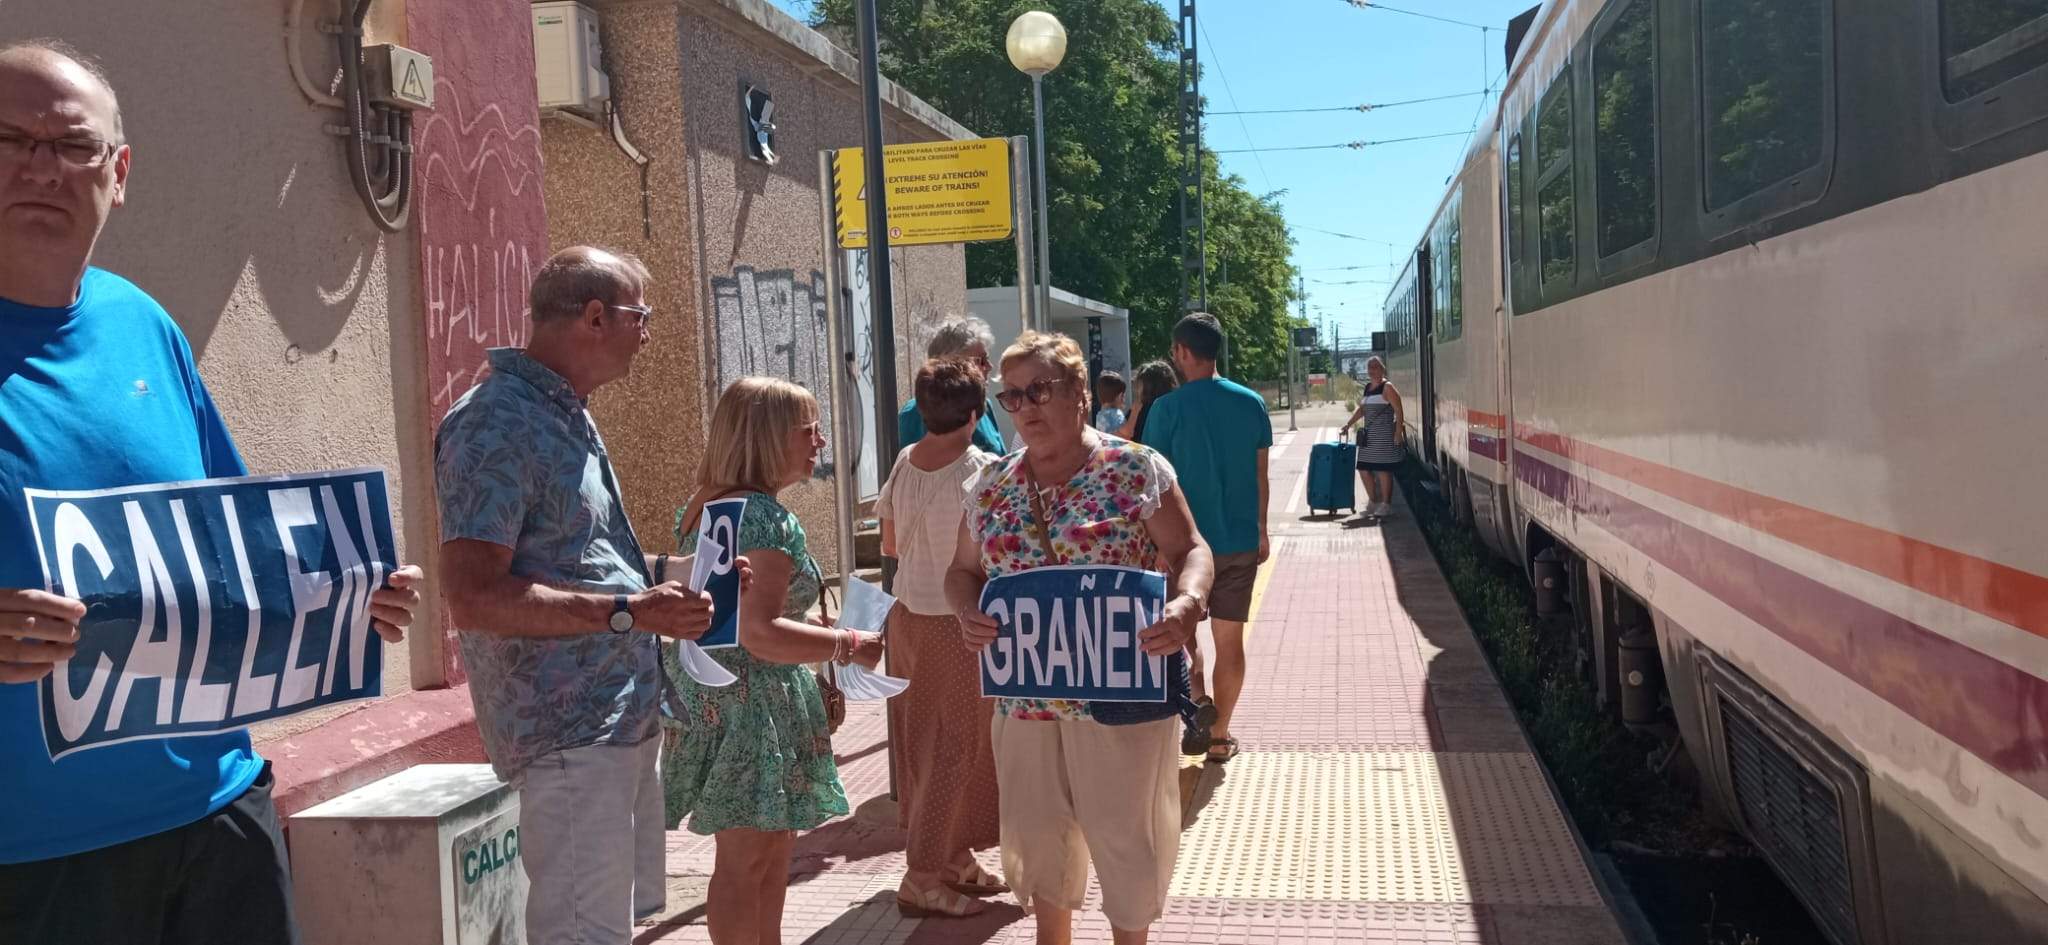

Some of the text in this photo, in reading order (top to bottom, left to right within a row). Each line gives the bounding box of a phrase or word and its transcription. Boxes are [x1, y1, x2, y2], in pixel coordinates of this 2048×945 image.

[928, 152, 959, 160] CROSSING
[928, 173, 940, 181] SU
[942, 169, 988, 180] ATENCIÓN!
[895, 182, 980, 194] BEWARE OF TRAINS!
[53, 480, 384, 743] CALLEN
